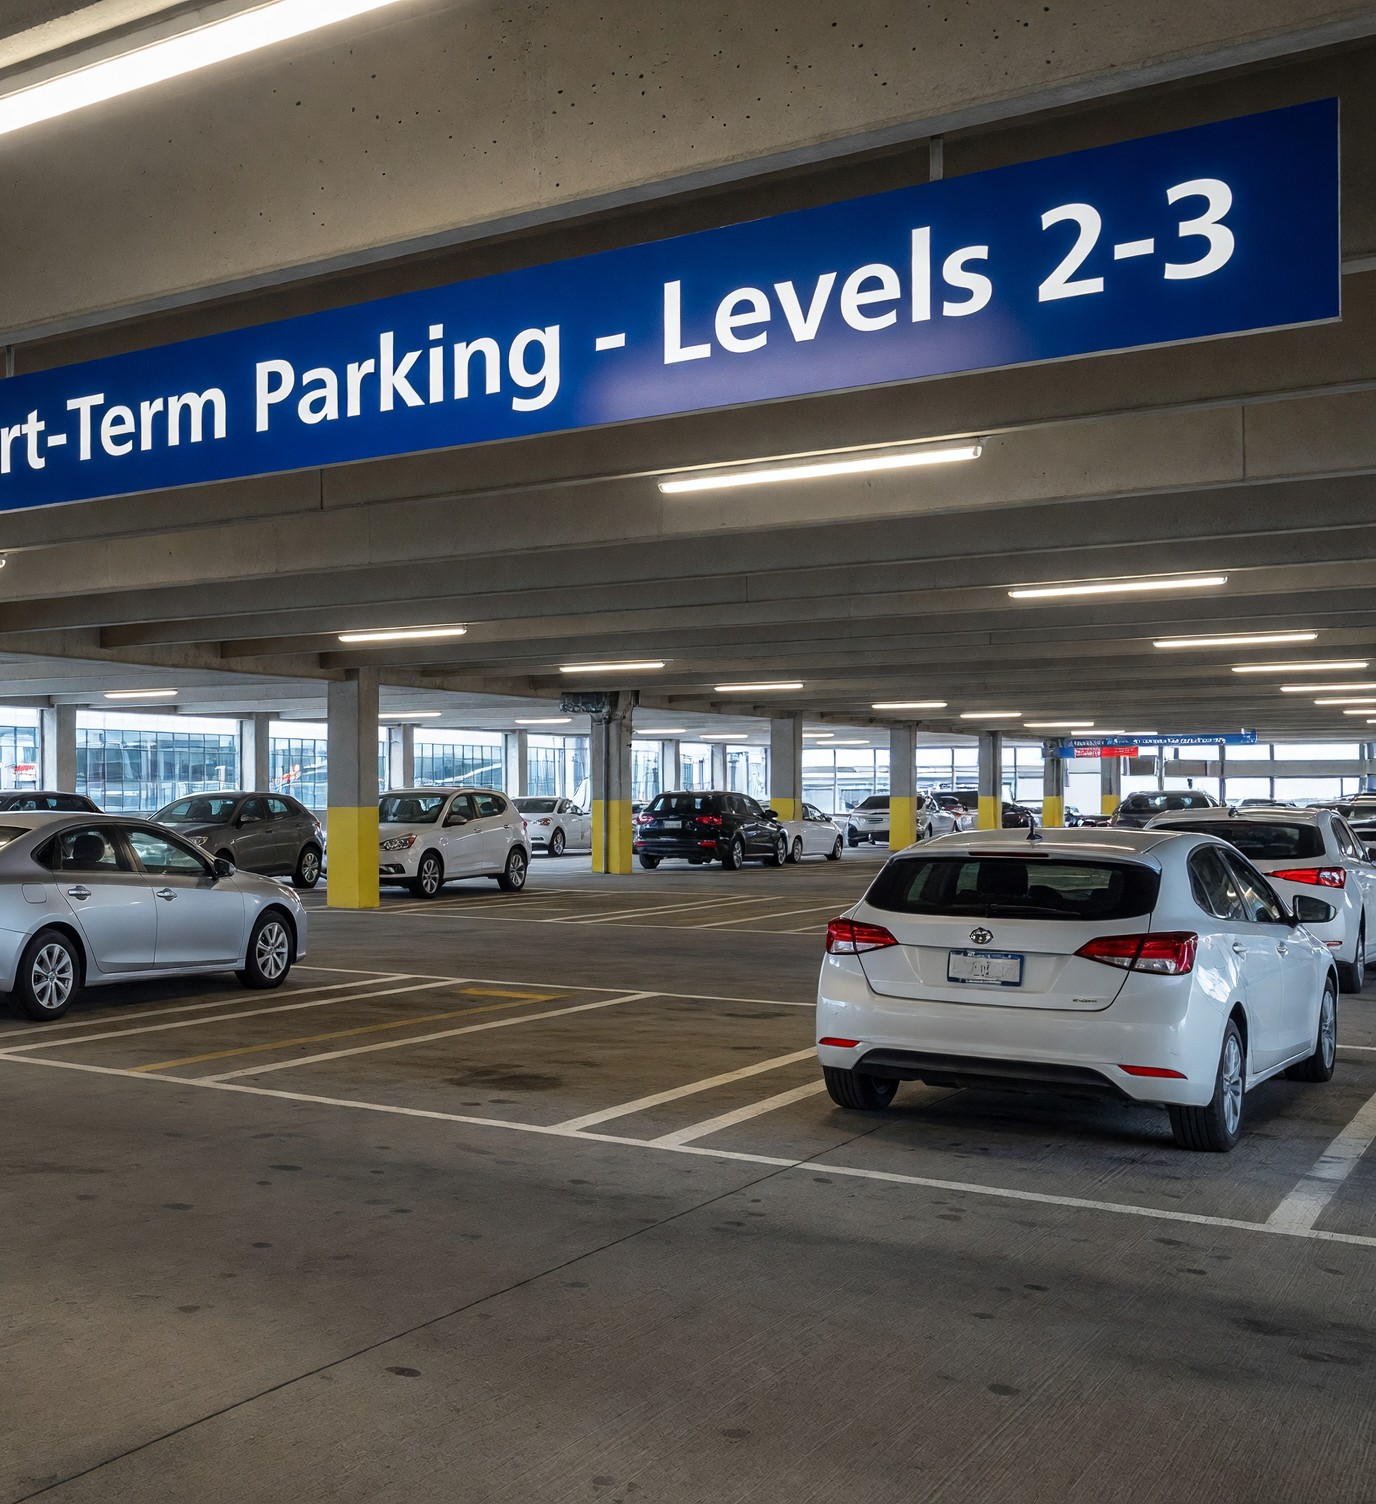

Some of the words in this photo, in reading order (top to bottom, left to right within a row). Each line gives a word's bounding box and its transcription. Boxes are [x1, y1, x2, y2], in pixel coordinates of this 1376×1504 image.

[255, 323, 560, 433] Parking
[595, 332, 626, 352] -
[663, 226, 993, 365] Levels
[1038, 178, 1235, 303] 2-3
